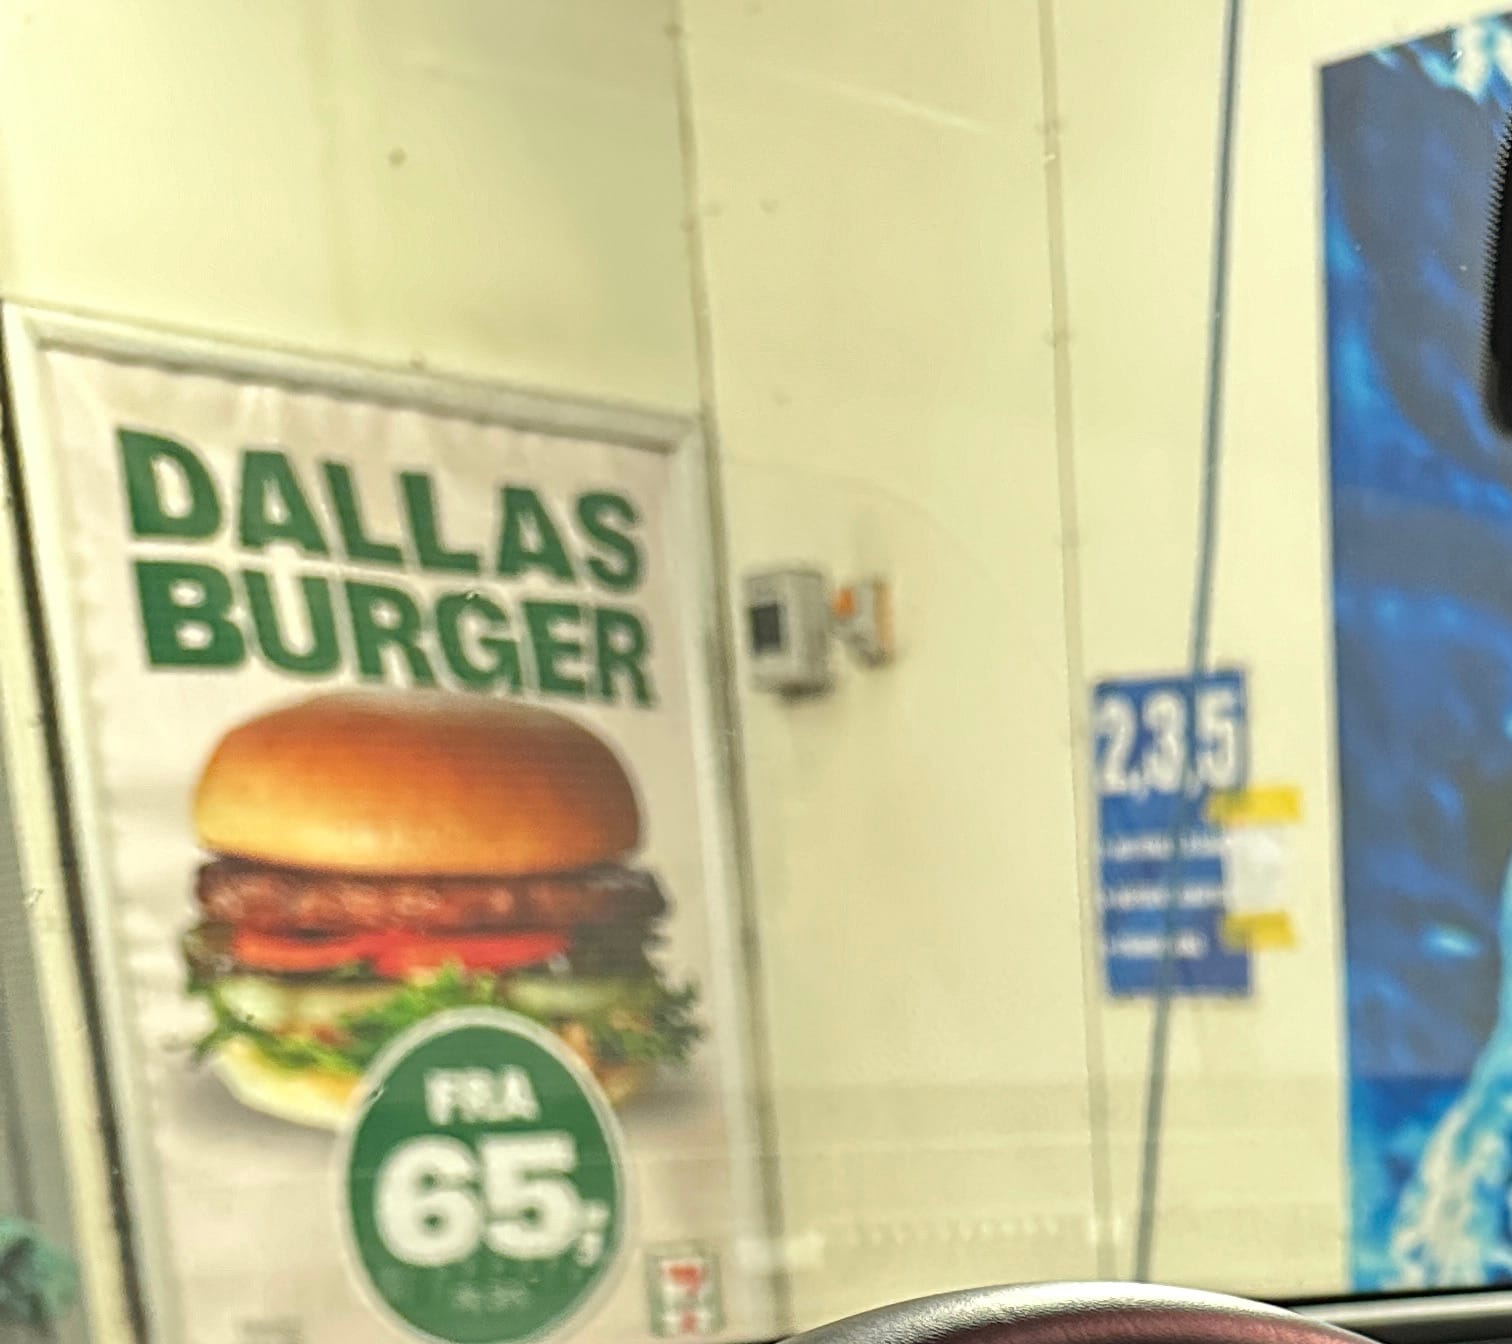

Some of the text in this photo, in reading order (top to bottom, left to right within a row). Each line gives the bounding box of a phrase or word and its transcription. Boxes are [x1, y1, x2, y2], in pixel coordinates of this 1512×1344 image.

[115, 426, 647, 595] DALLAS
[133, 558, 658, 709] BURGER
[424, 1064, 540, 1126] FRA
